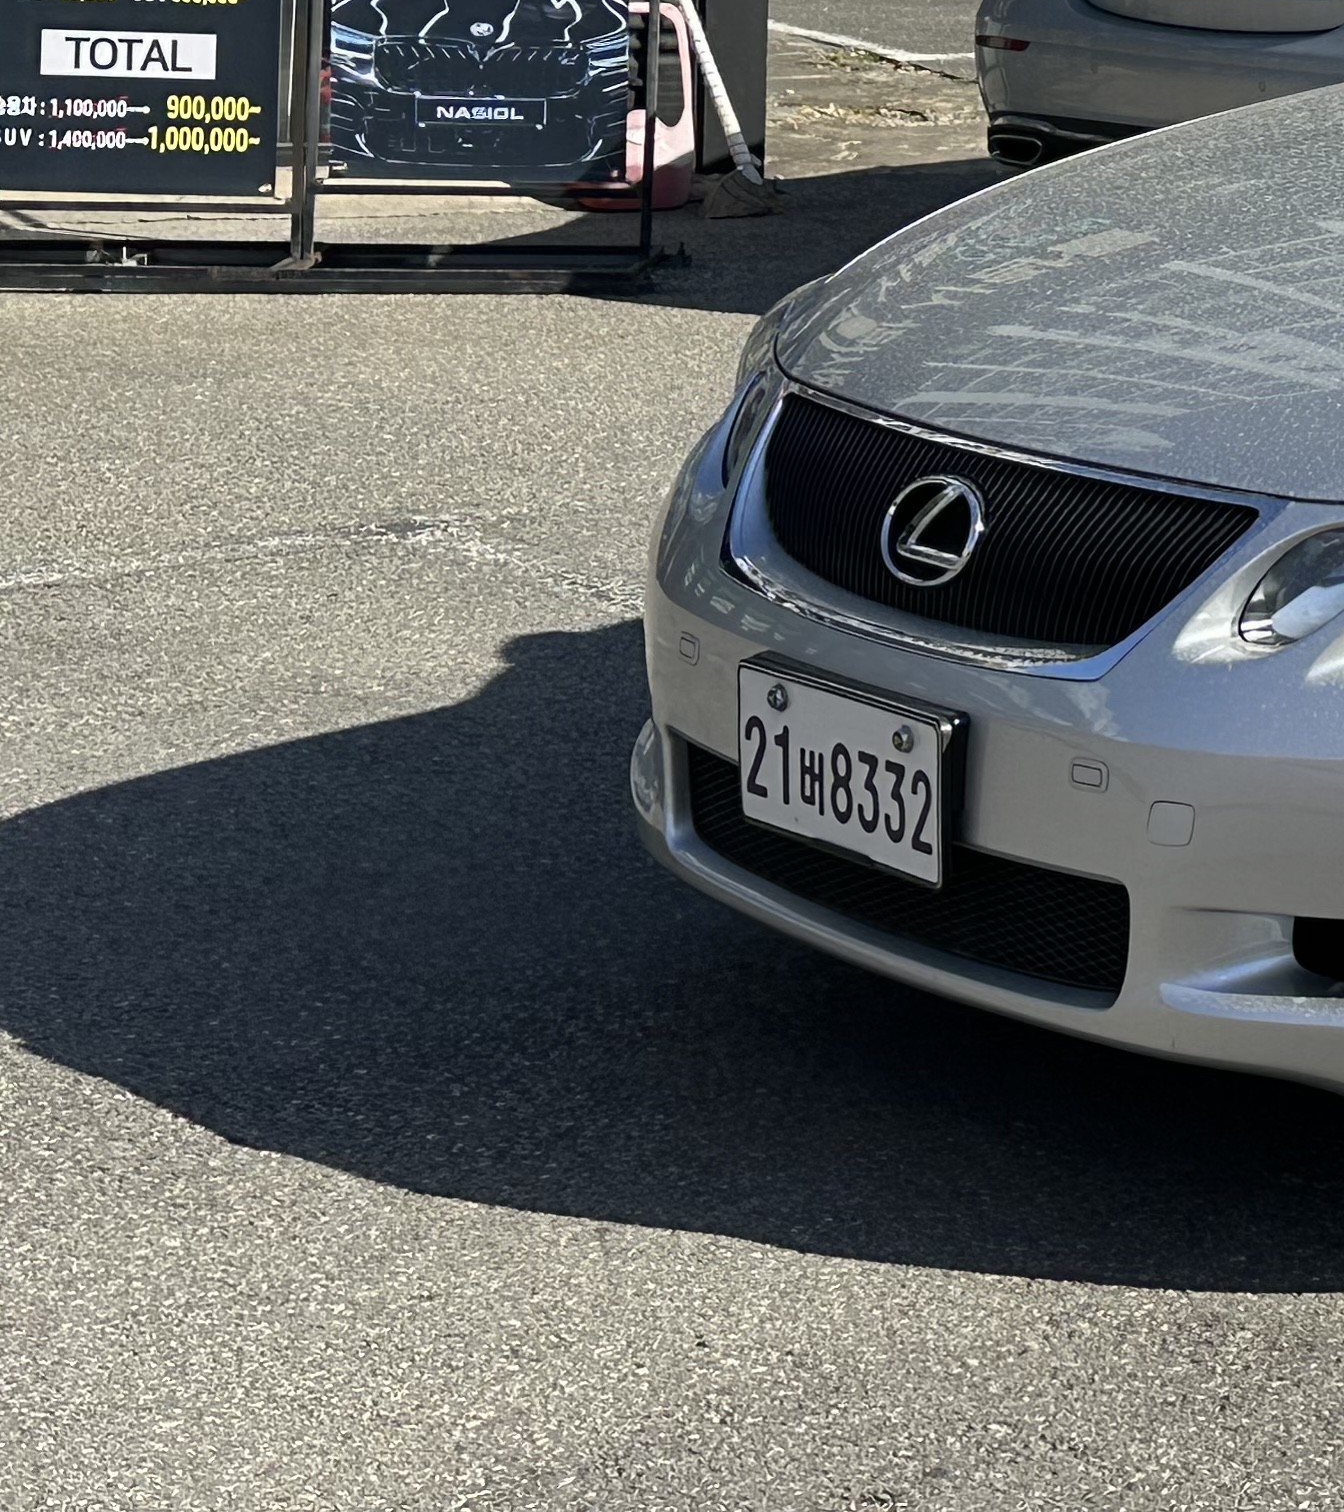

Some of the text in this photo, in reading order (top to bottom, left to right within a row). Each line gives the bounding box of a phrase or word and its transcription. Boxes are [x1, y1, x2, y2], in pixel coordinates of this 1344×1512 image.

[65, 36, 193, 73] TOTAL
[435, 104, 525, 121] NASIOL
[0, 128, 32, 147] UV
